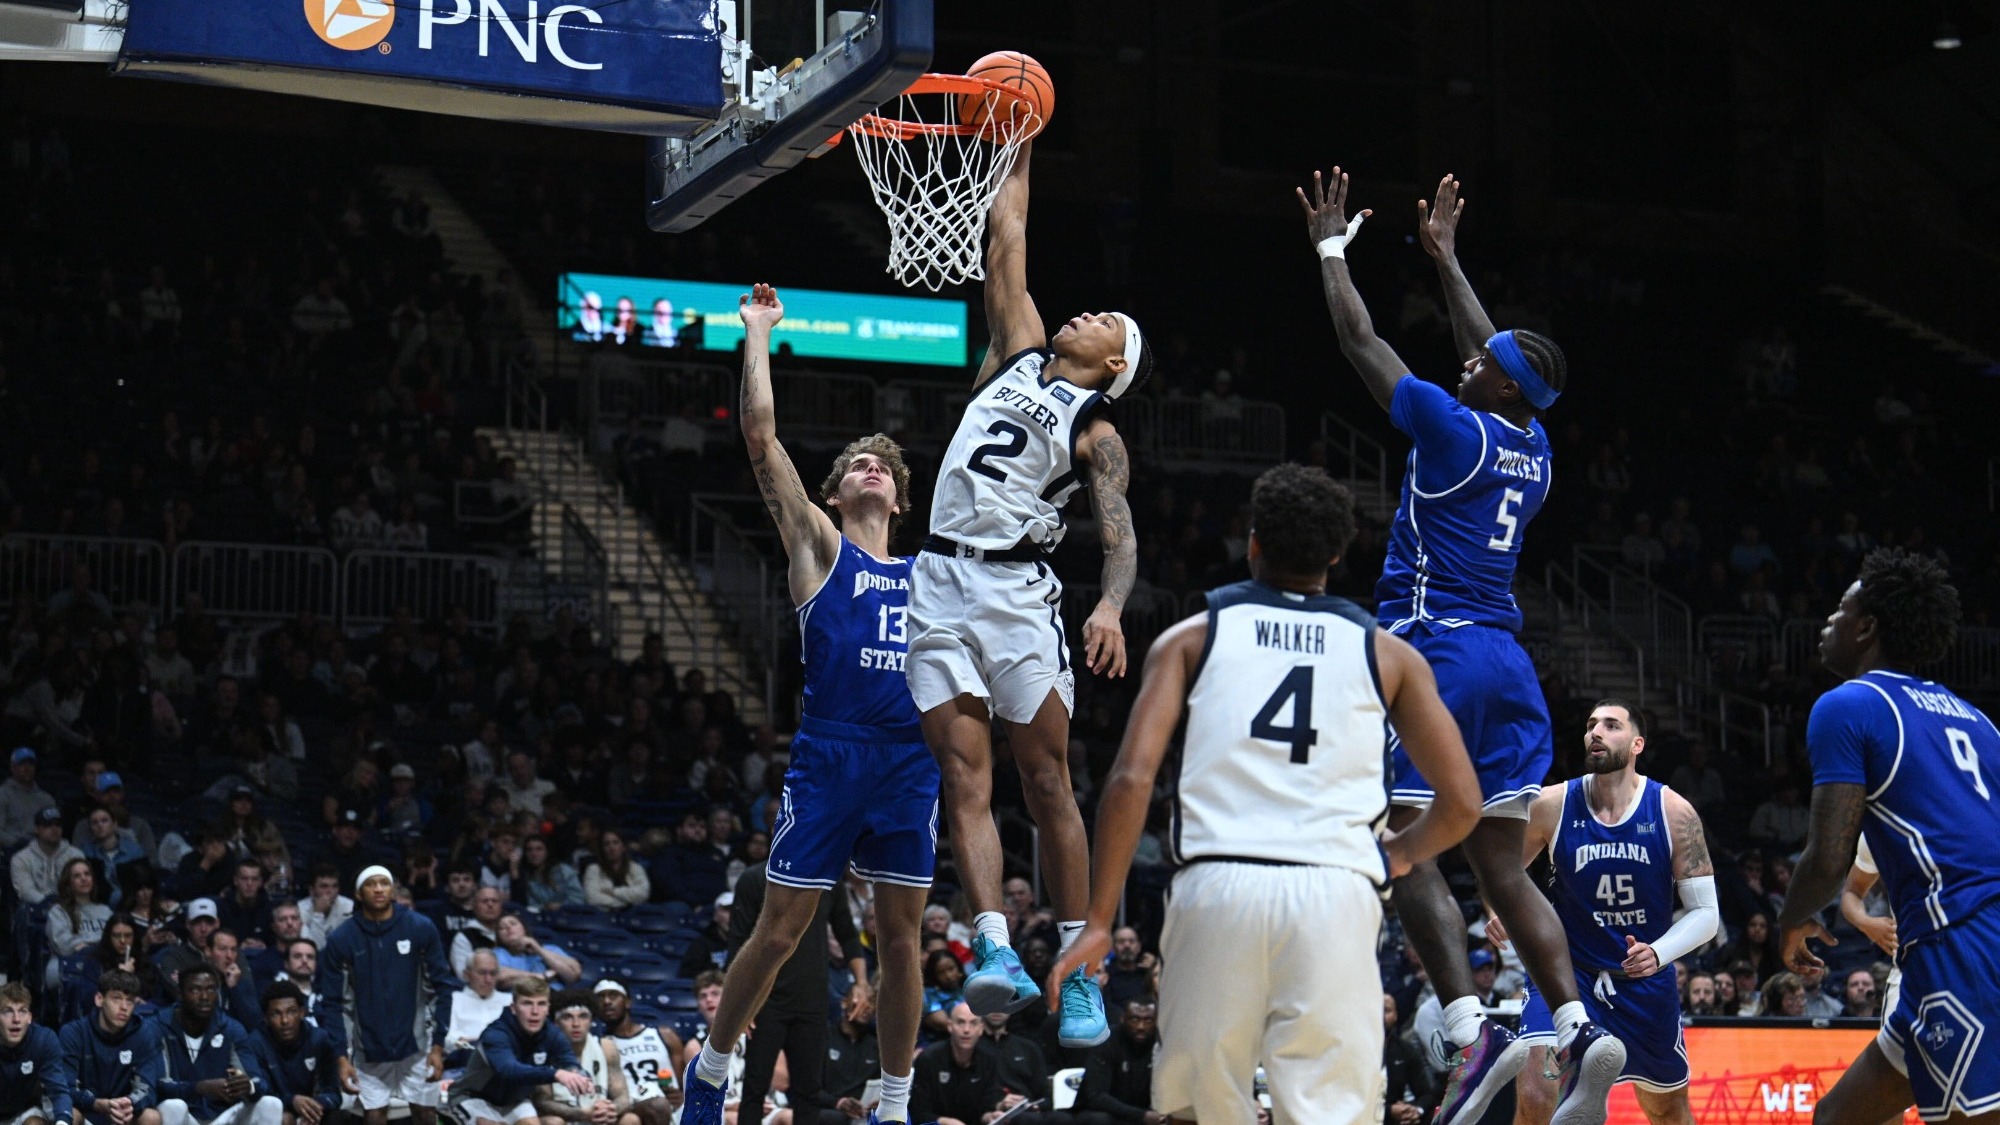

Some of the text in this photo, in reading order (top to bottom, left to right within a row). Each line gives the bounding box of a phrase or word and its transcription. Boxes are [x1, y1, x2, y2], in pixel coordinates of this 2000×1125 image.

[418, 0, 604, 70] PNC
[992, 386, 1059, 436] BUTLER
[966, 419, 1029, 484] 2
[1488, 487, 1524, 552] 5
[963, 544, 976, 559] B
[878, 604, 909, 644] 13
[1255, 619, 1326, 655] WALKER
[1250, 665, 1318, 765] 4
[1945, 727, 1991, 801] 9
[1574, 842, 1651, 875] INDIANA
[1595, 874, 1636, 907] 45
[1593, 909, 1648, 928] STATE
[623, 1059, 659, 1085] 13
[1760, 1083, 1814, 1113] WE
